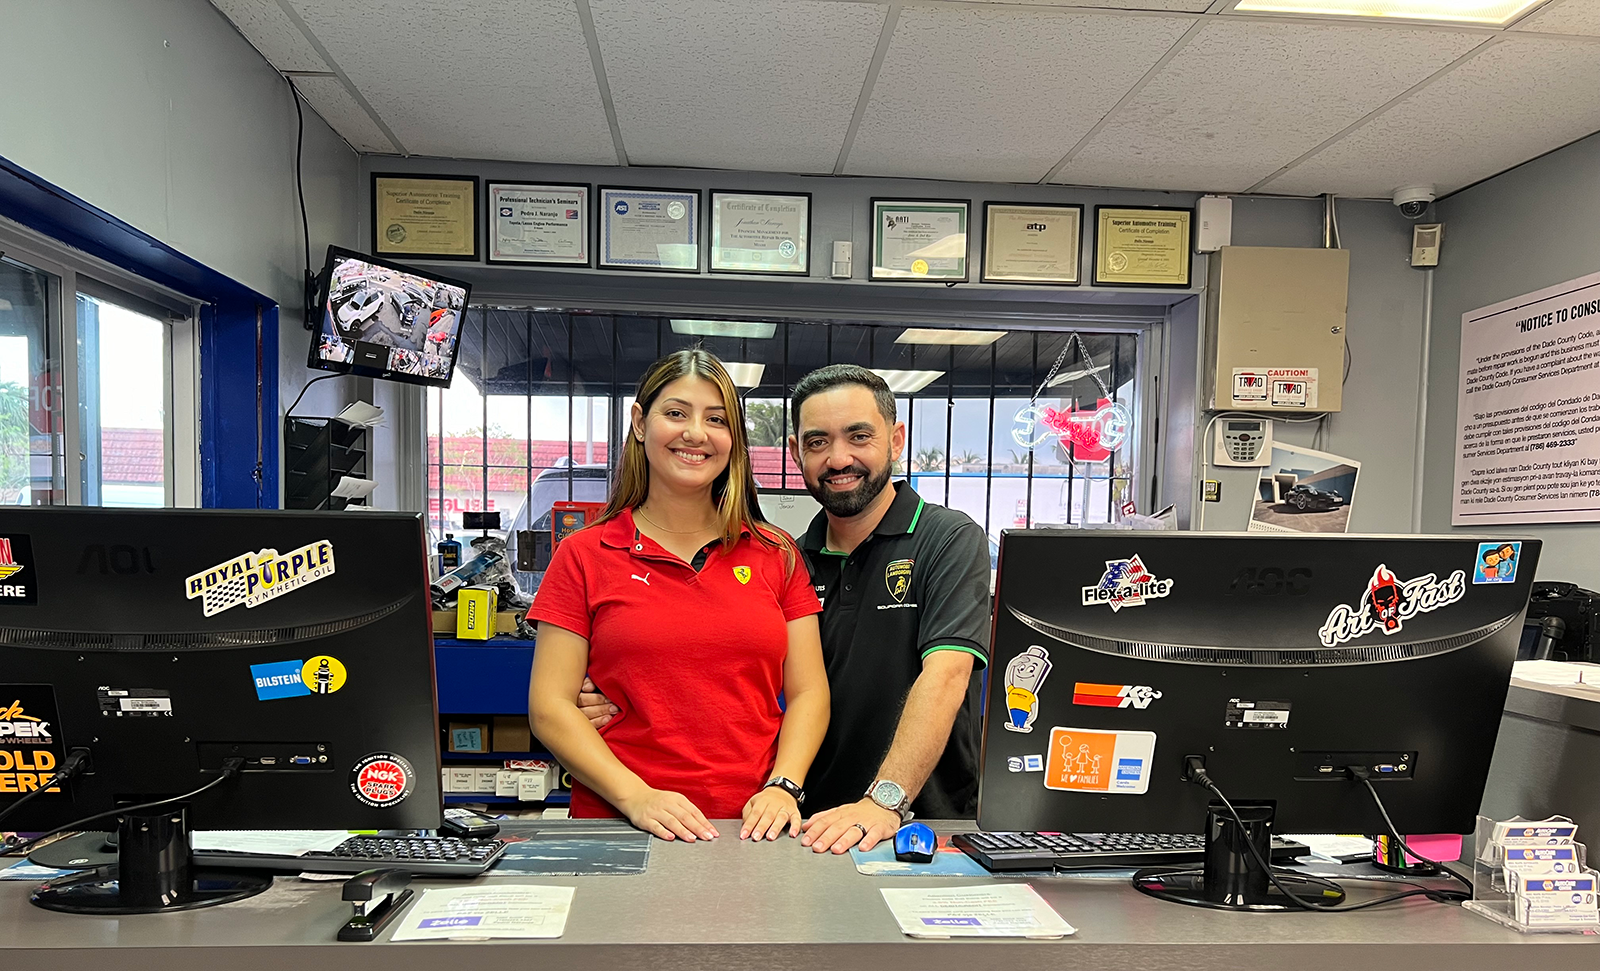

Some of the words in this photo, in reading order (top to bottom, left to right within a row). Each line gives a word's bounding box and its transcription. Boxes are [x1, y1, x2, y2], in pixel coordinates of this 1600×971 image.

[1026, 223, 1046, 232] atp
[1556, 308, 1568, 324] TO
[1557, 335, 1576, 344] County
[1267, 369, 1309, 377] CAUTION!
[1560, 362, 1593, 375] Department
[1239, 377, 1263, 387] TRIAD
[1277, 383, 1302, 394] TRIAD
[1557, 396, 1582, 407] Condado
[1533, 462, 1551, 471] County
[190, 557, 254, 594] ROYAL
[246, 543, 331, 596] PURPLE
[247, 574, 308, 606] SYNTHETIC
[314, 566, 332, 578] OIL
[1225, 567, 1313, 597] AOC
[1084, 581, 1167, 602] Flex-a-lite
[1322, 604, 1374, 645] Art
[1381, 606, 1395, 618] OF
[1398, 571, 1465, 616] Fast
[255, 673, 301, 688] BILSTEIN
[0, 750, 56, 771] OLD
[367, 769, 398, 782] NGK
[1077, 775, 1099, 785] FAMILIES
[366, 787, 394, 796] PLUGS
[367, 782, 396, 790] SPARK
